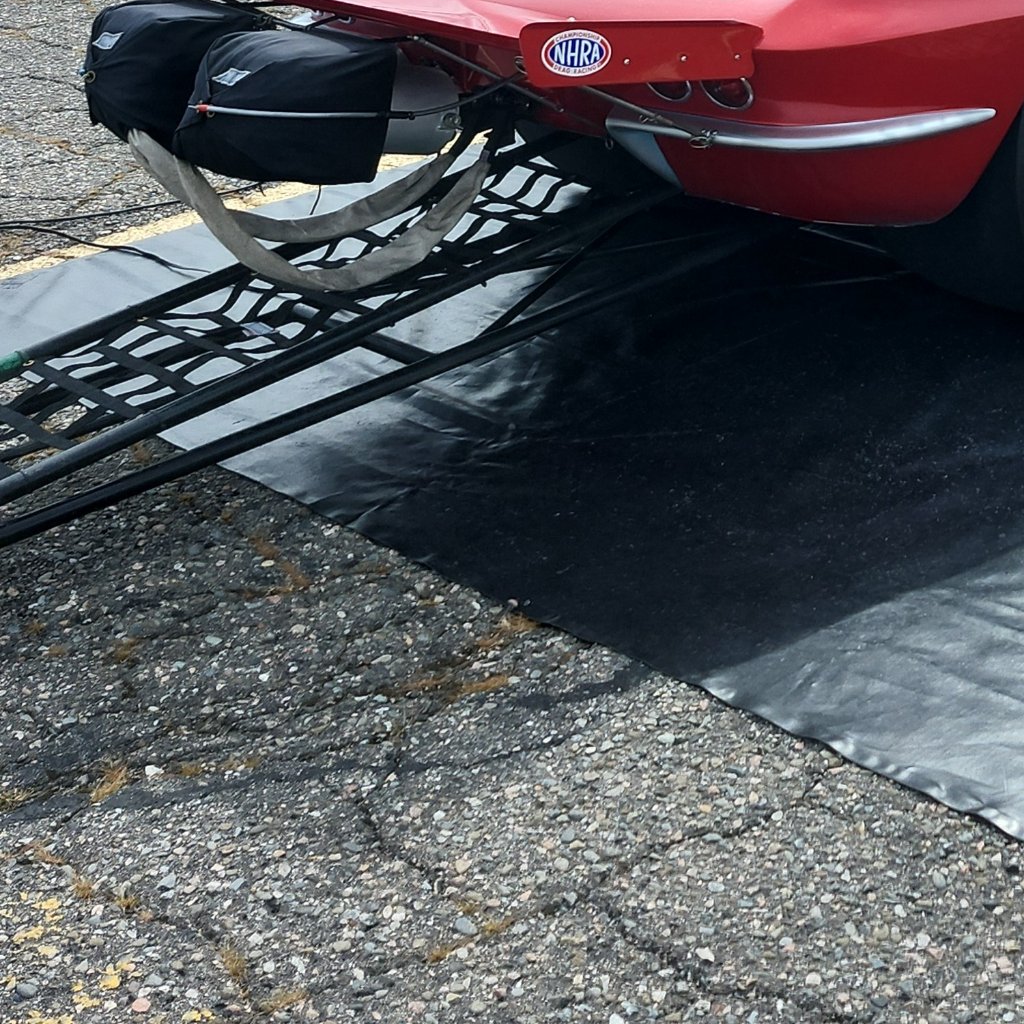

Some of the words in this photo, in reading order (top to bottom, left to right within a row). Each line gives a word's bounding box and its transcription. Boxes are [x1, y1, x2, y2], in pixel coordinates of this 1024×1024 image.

[555, 31, 601, 43] CHAMPIONSHIP
[554, 39, 601, 67] NHRA
[553, 64, 571, 74] DRAG
[573, 64, 597, 74] RACING
